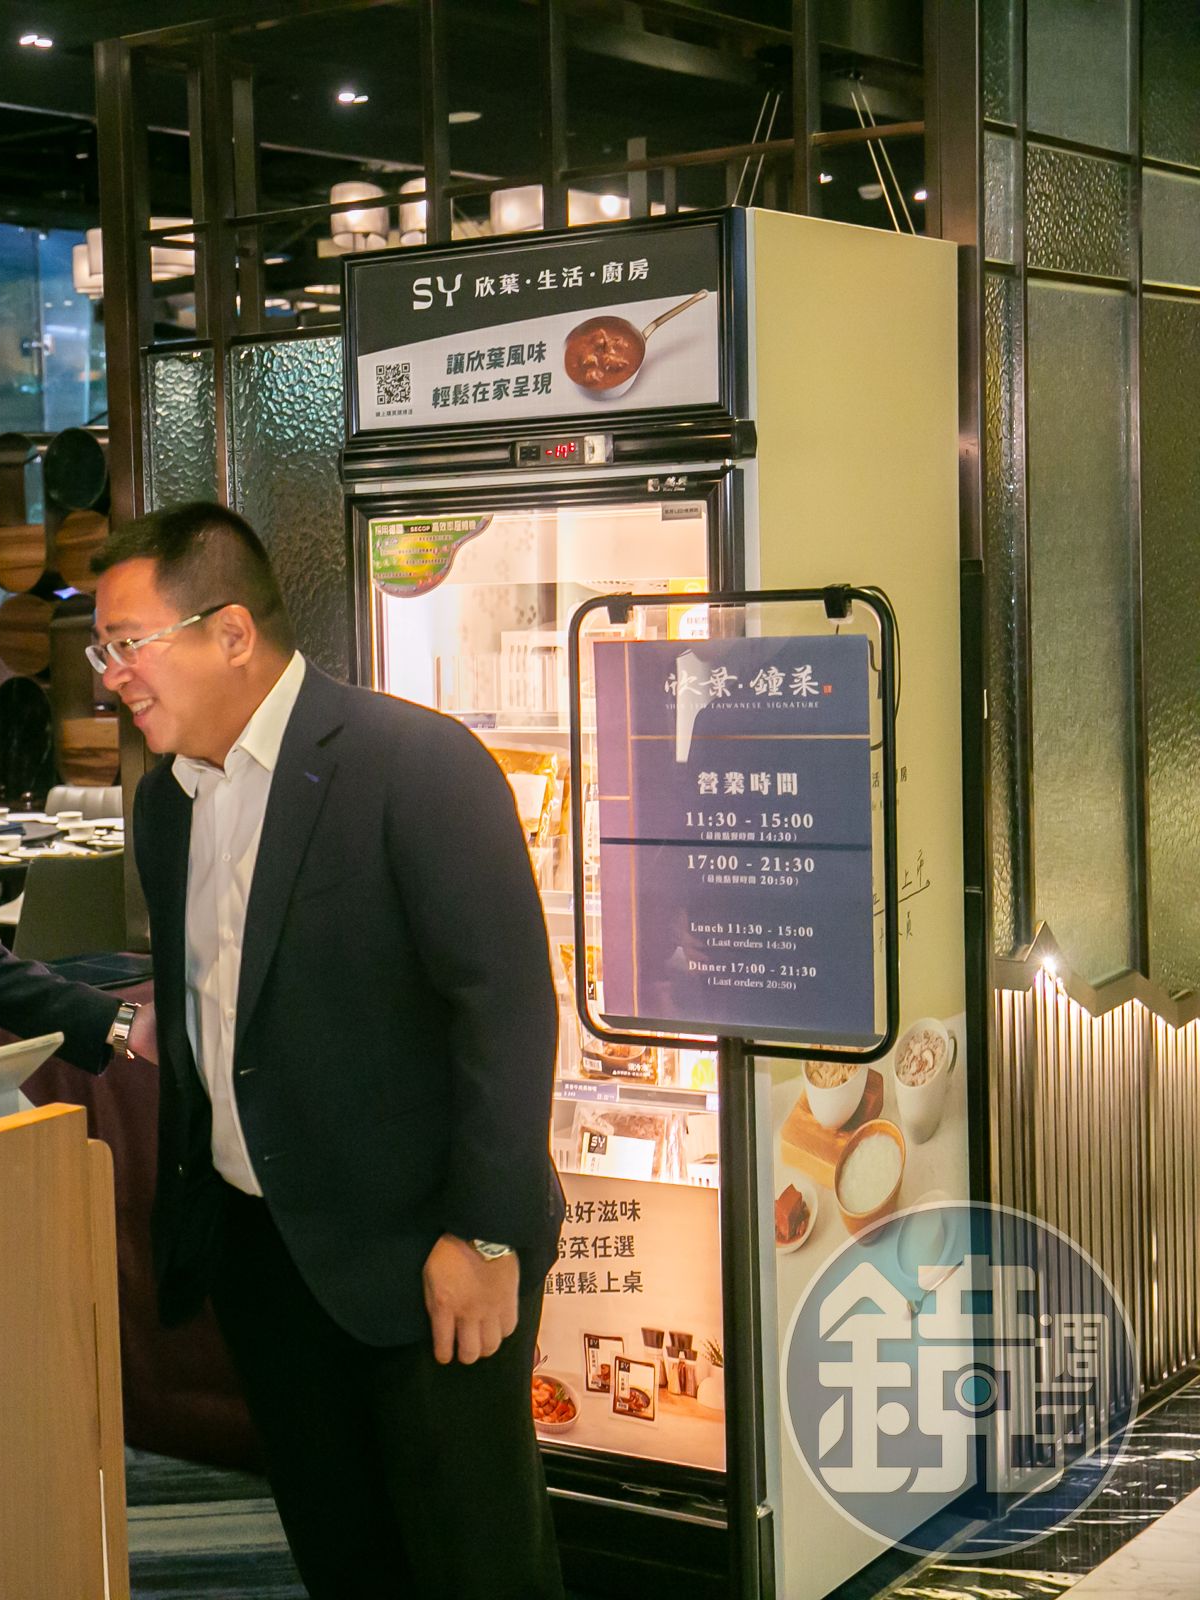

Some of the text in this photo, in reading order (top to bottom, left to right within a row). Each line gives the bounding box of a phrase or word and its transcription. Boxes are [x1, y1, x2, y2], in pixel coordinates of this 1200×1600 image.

[412, 273, 463, 310] SY
[446, 340, 548, 376] 讓欣葉風味
[432, 372, 553, 410] 輕鬆在家呈現
[766, 700, 819, 709] SIGNATURE
[697, 771, 799, 796] 營業時間
[685, 811, 737, 828] 11:30
[760, 812, 814, 829] 15:00
[687, 854, 739, 871] 17:00
[760, 856, 815, 873] 21:30
[691, 922, 724, 934] Lunch
[727, 923, 763, 936] 11:30
[778, 925, 814, 938] 15:00
[733, 939, 763, 949] orders
[688, 960, 727, 973] Dinner
[730, 962, 766, 975] 17:00
[780, 965, 817, 978] 21:30
[734, 978, 764, 988] orders
[590, 1134, 606, 1148] SY
